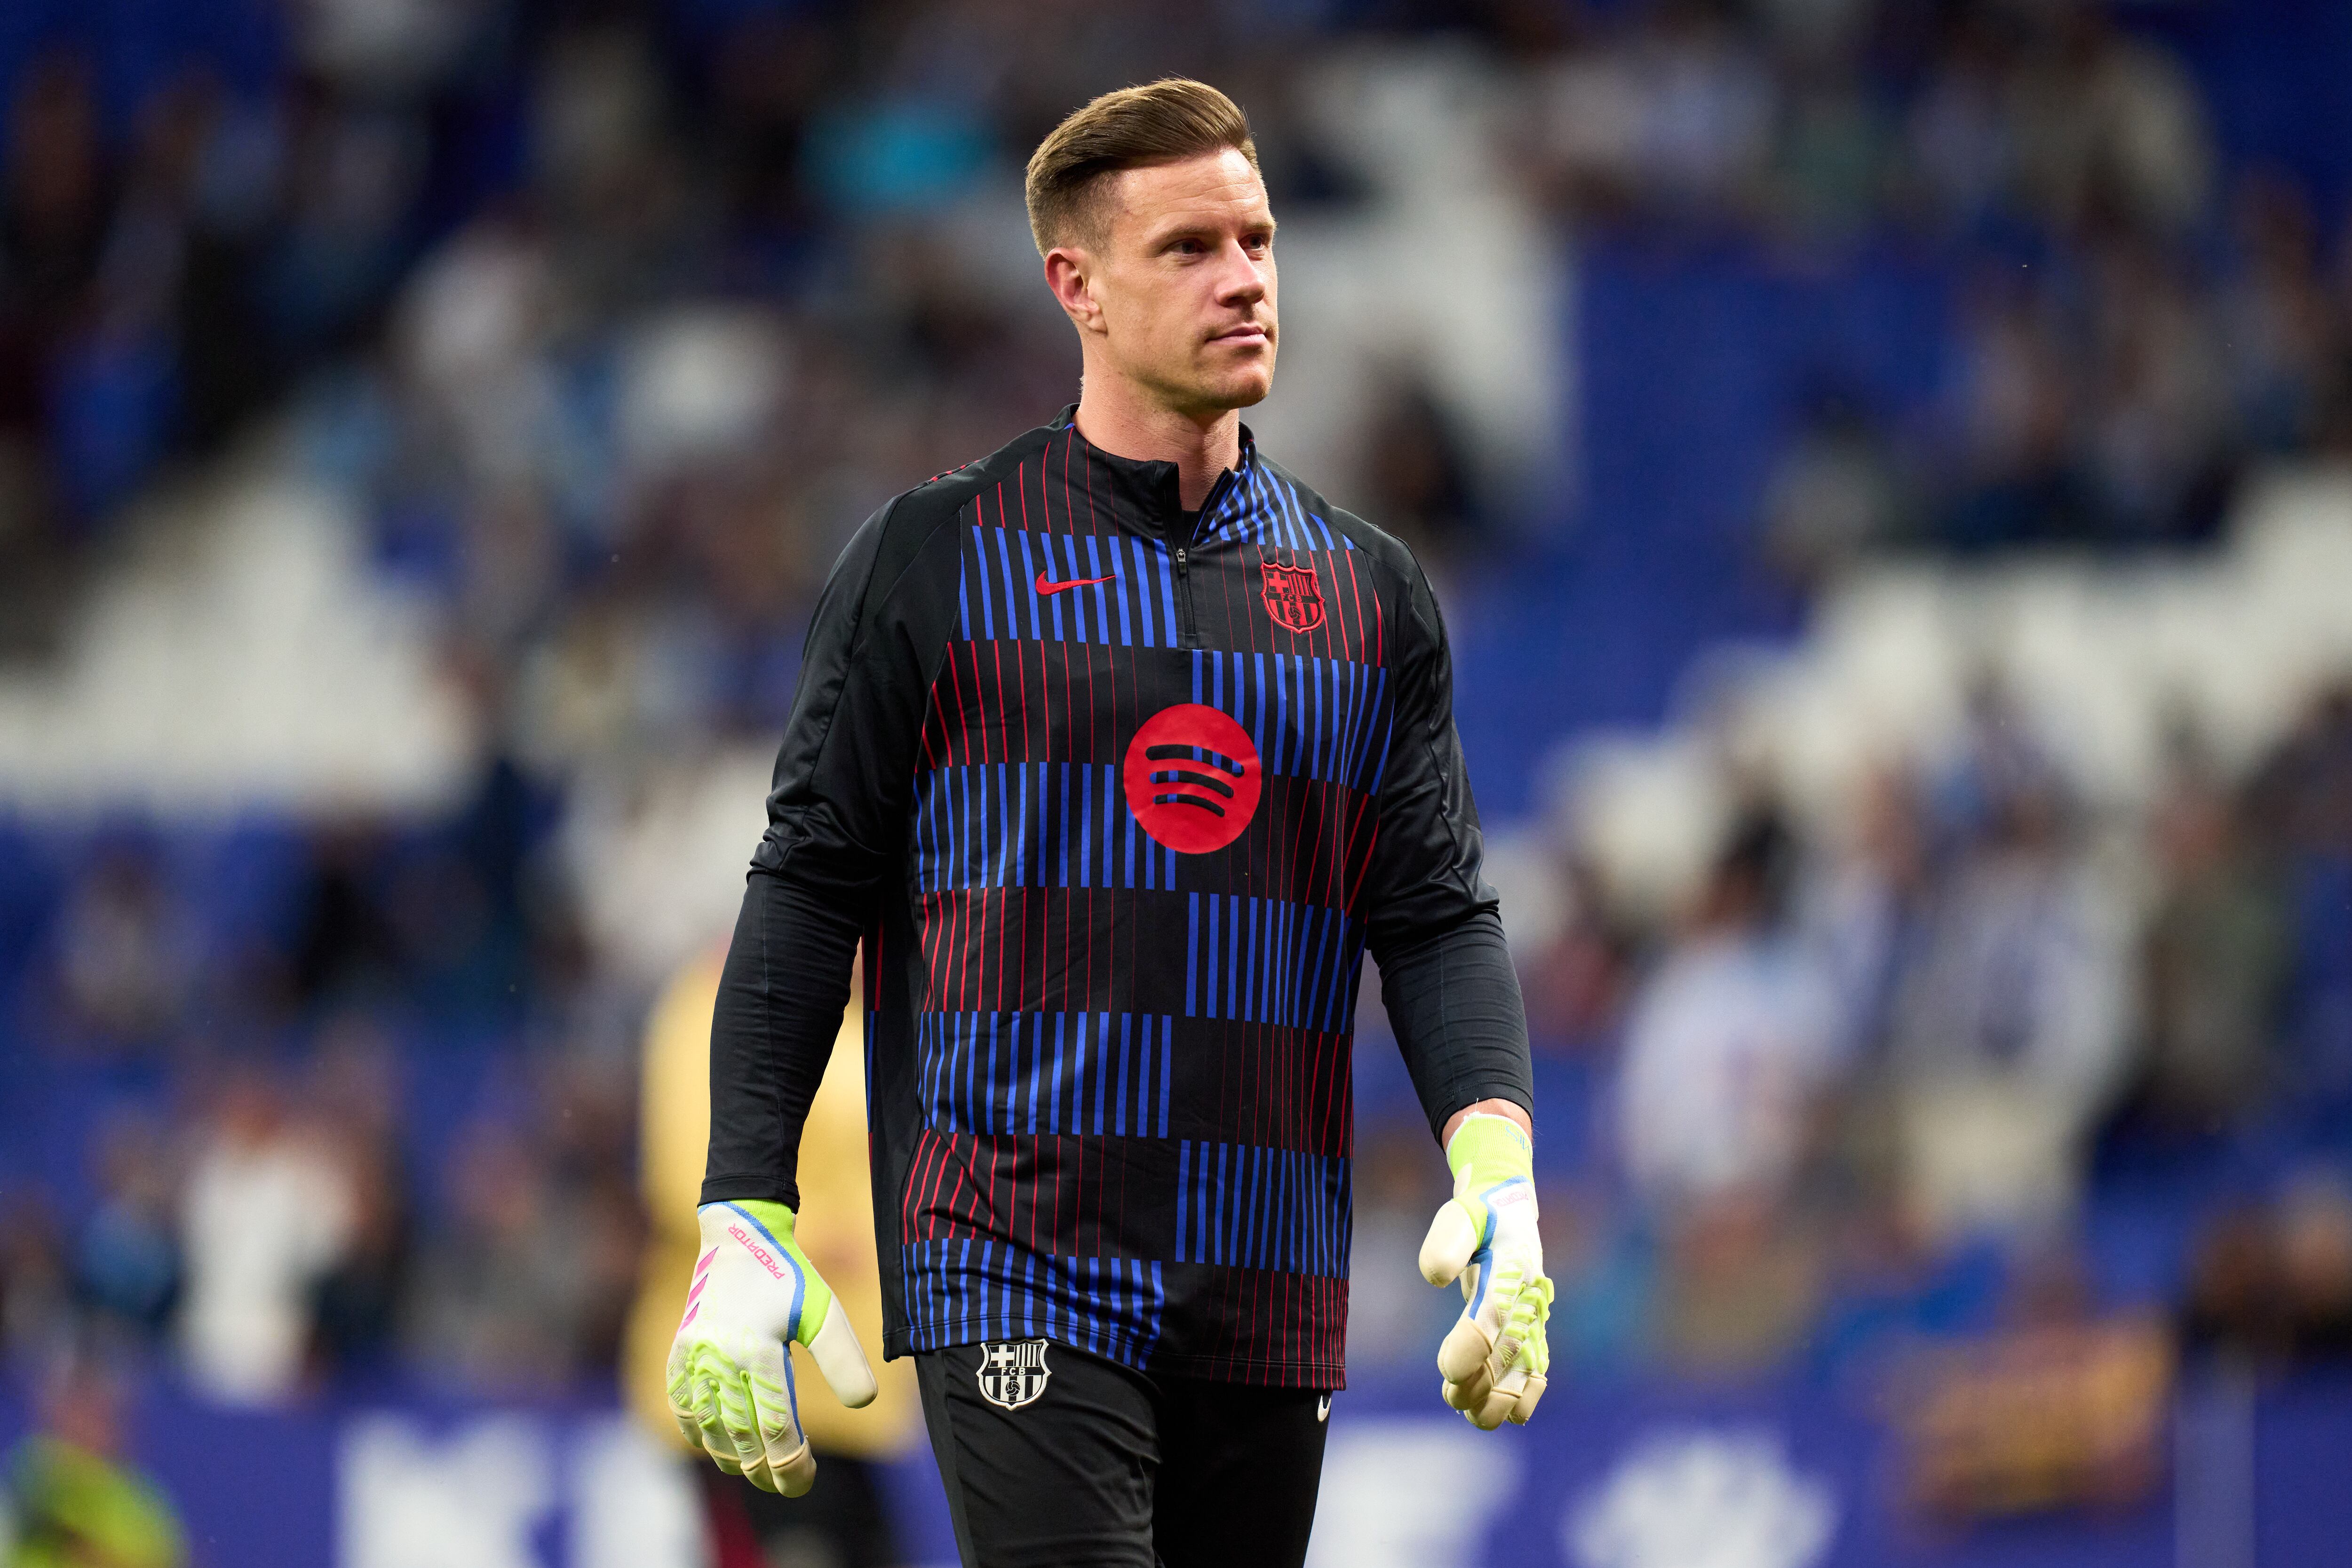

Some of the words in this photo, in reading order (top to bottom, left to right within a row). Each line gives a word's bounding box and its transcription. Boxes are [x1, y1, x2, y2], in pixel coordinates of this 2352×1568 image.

[1280, 594, 1302, 602] FCB
[728, 1223, 786, 1280] PREDATOR
[1001, 1367, 1025, 1376] FCB
